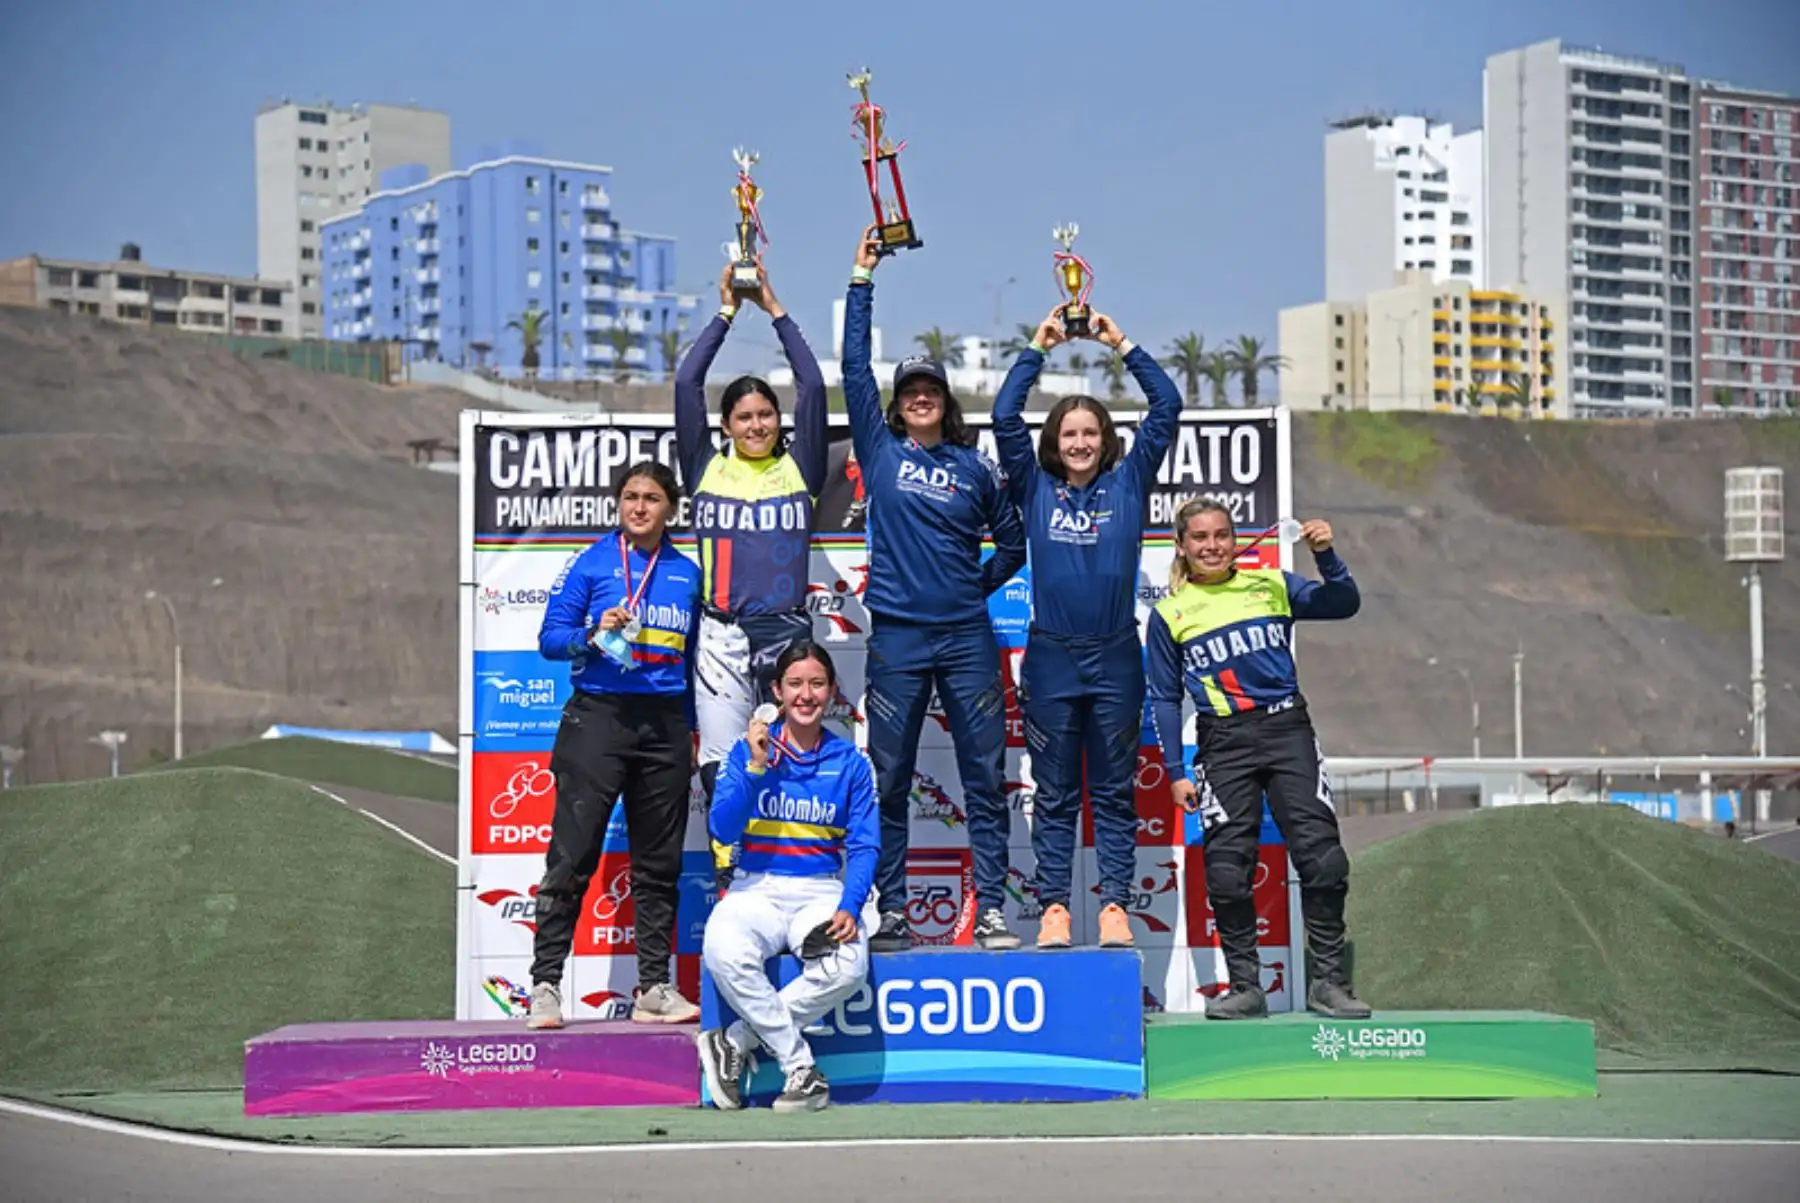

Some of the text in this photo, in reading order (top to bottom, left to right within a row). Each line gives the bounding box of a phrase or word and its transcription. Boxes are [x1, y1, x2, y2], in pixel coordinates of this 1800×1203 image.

[1149, 491, 1196, 523] BM
[1203, 491, 1256, 523] 21
[527, 679, 554, 690] san
[500, 688, 554, 708] miguel
[758, 787, 837, 824] Colombia
[490, 826, 552, 843] FDPC
